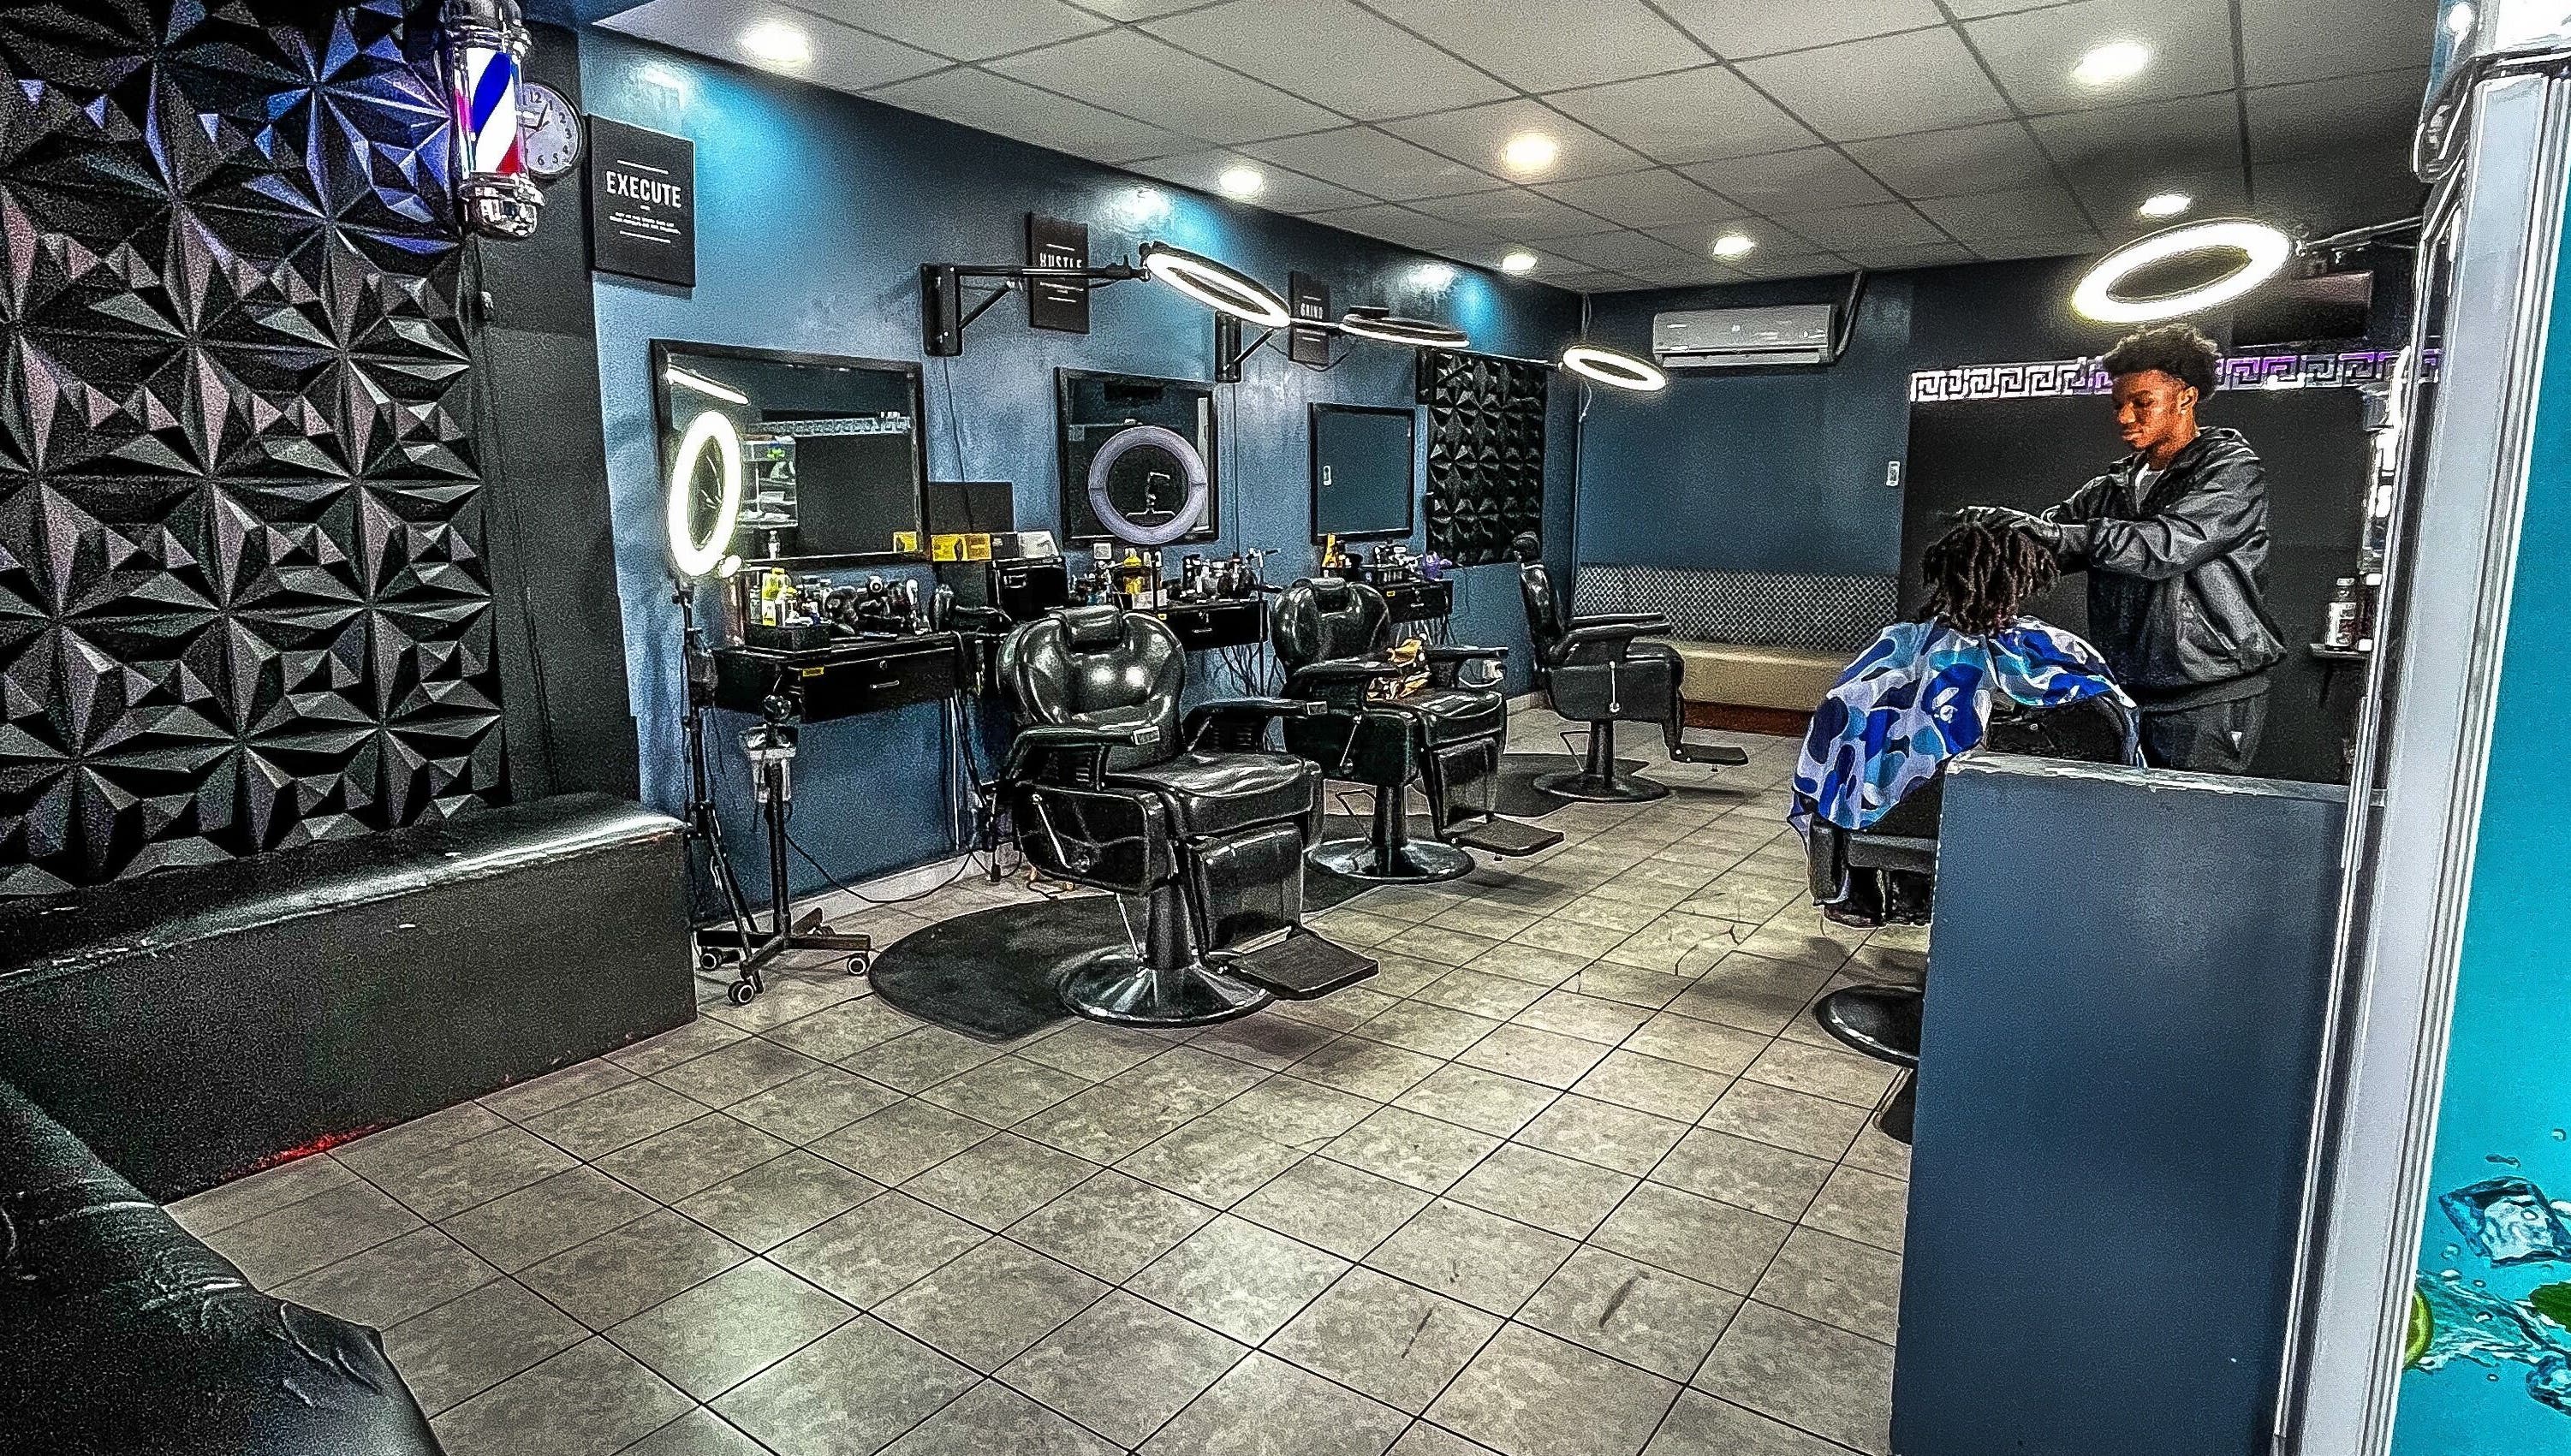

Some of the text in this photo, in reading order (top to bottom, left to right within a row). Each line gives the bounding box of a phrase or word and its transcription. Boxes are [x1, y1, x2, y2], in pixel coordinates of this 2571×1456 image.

[530, 89, 542, 104] 12
[559, 112, 566, 124] 2
[565, 128, 572, 140] 3
[562, 145, 569, 154] 4
[537, 154, 545, 166] 6
[552, 152, 559, 164] 5
[605, 170, 682, 208] EXECUTE
[1039, 252, 1083, 268] HUSTLE
